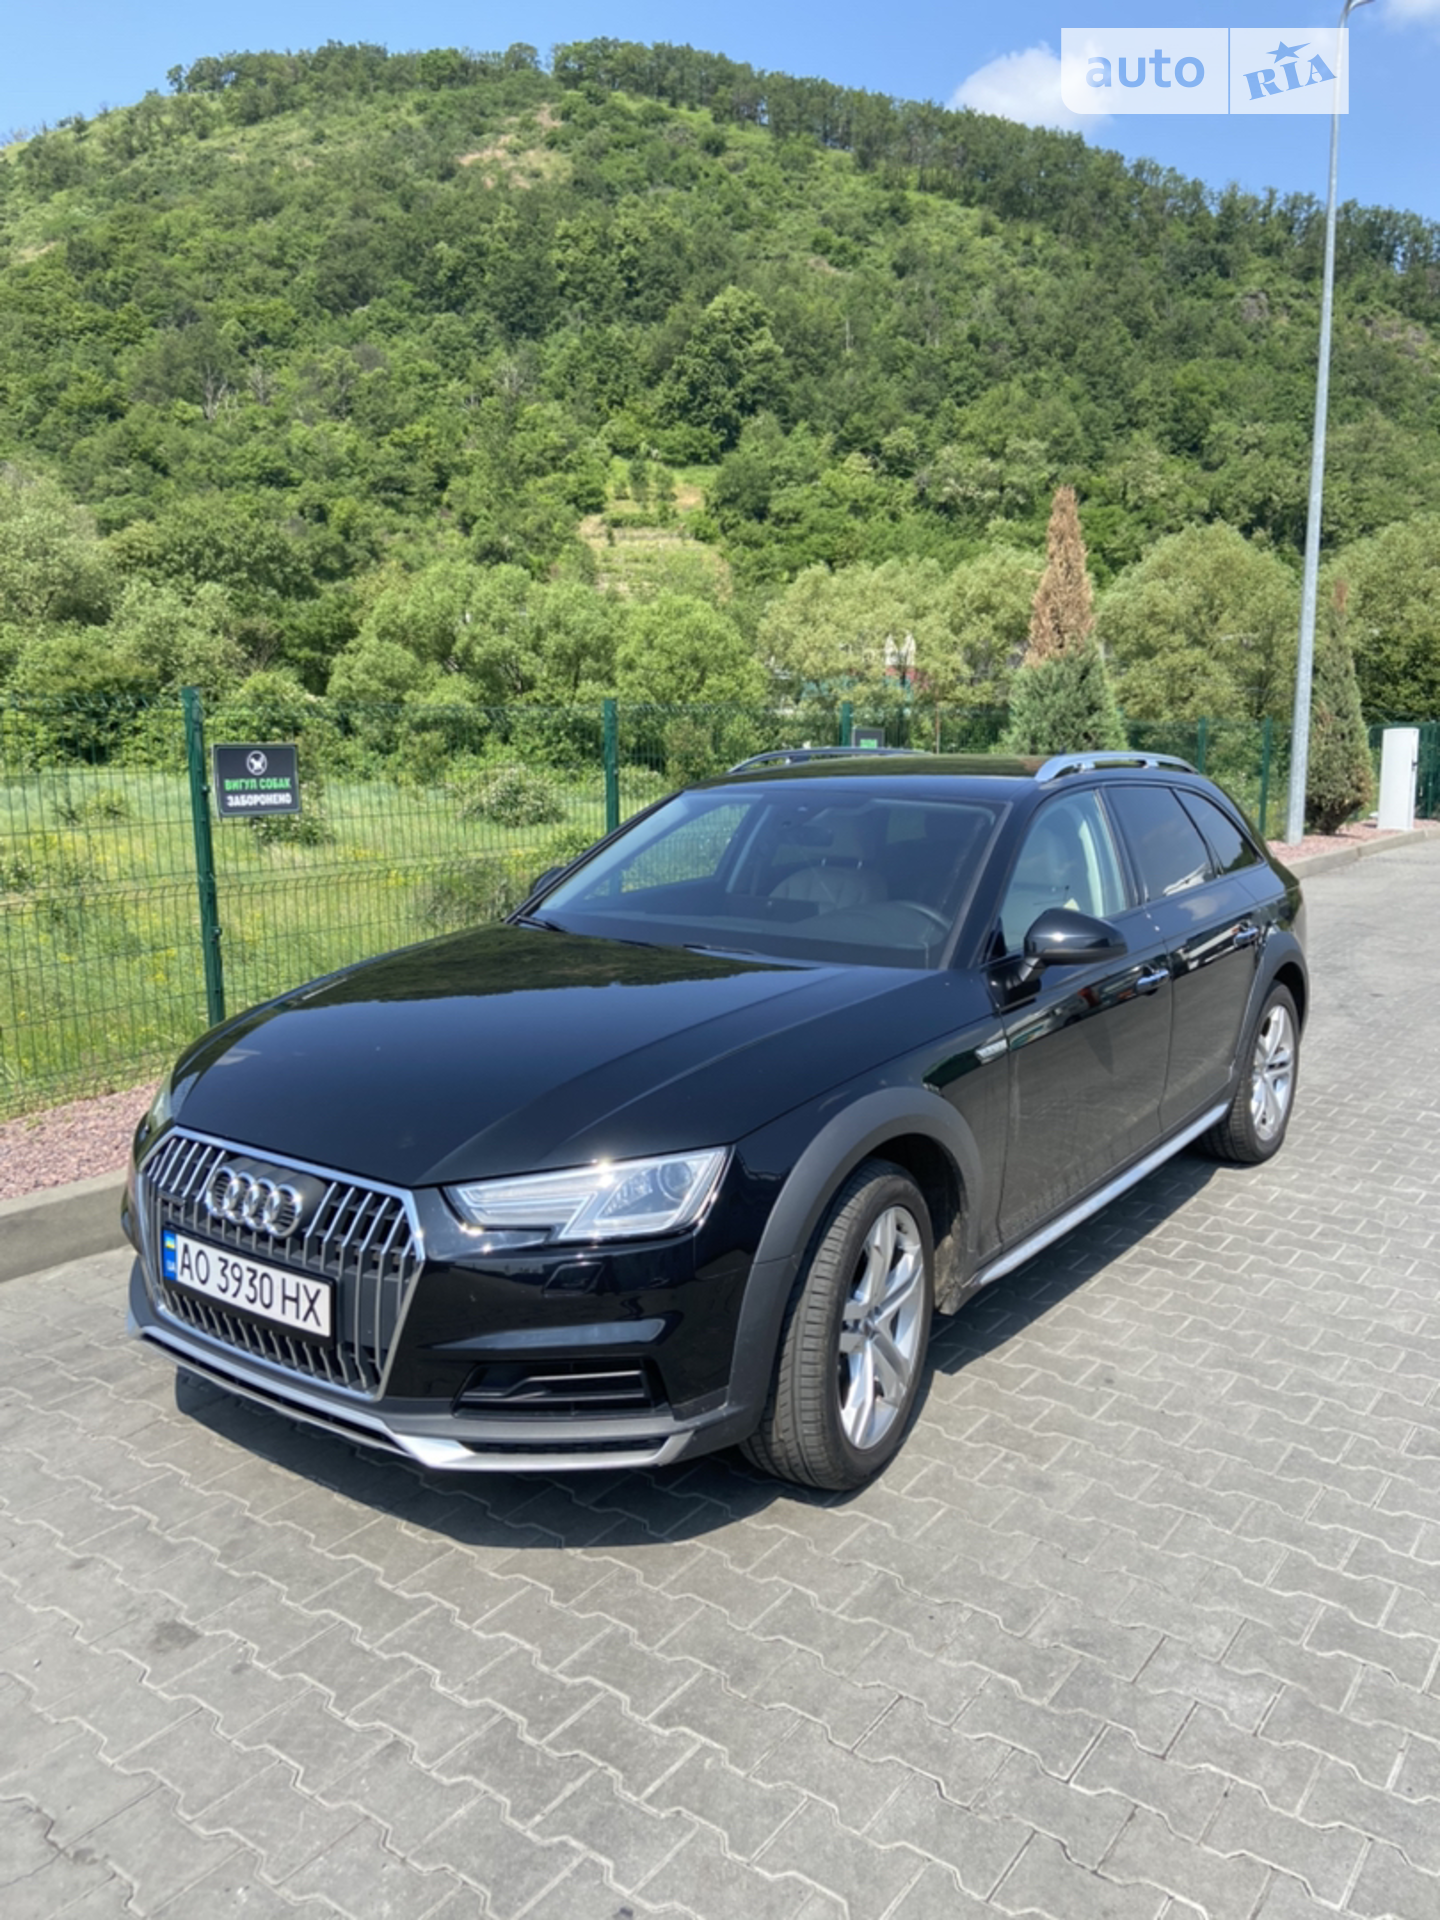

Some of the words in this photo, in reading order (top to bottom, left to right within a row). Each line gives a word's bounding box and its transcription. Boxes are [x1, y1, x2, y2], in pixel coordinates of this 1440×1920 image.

[224, 778, 257, 792] ВИГУЛ
[259, 777, 292, 790] СОБАК
[226, 793, 293, 807] ЗАБОРОНЕНО
[179, 1242, 211, 1286] AO
[216, 1256, 275, 1310] 3930
[281, 1277, 322, 1328] HX
